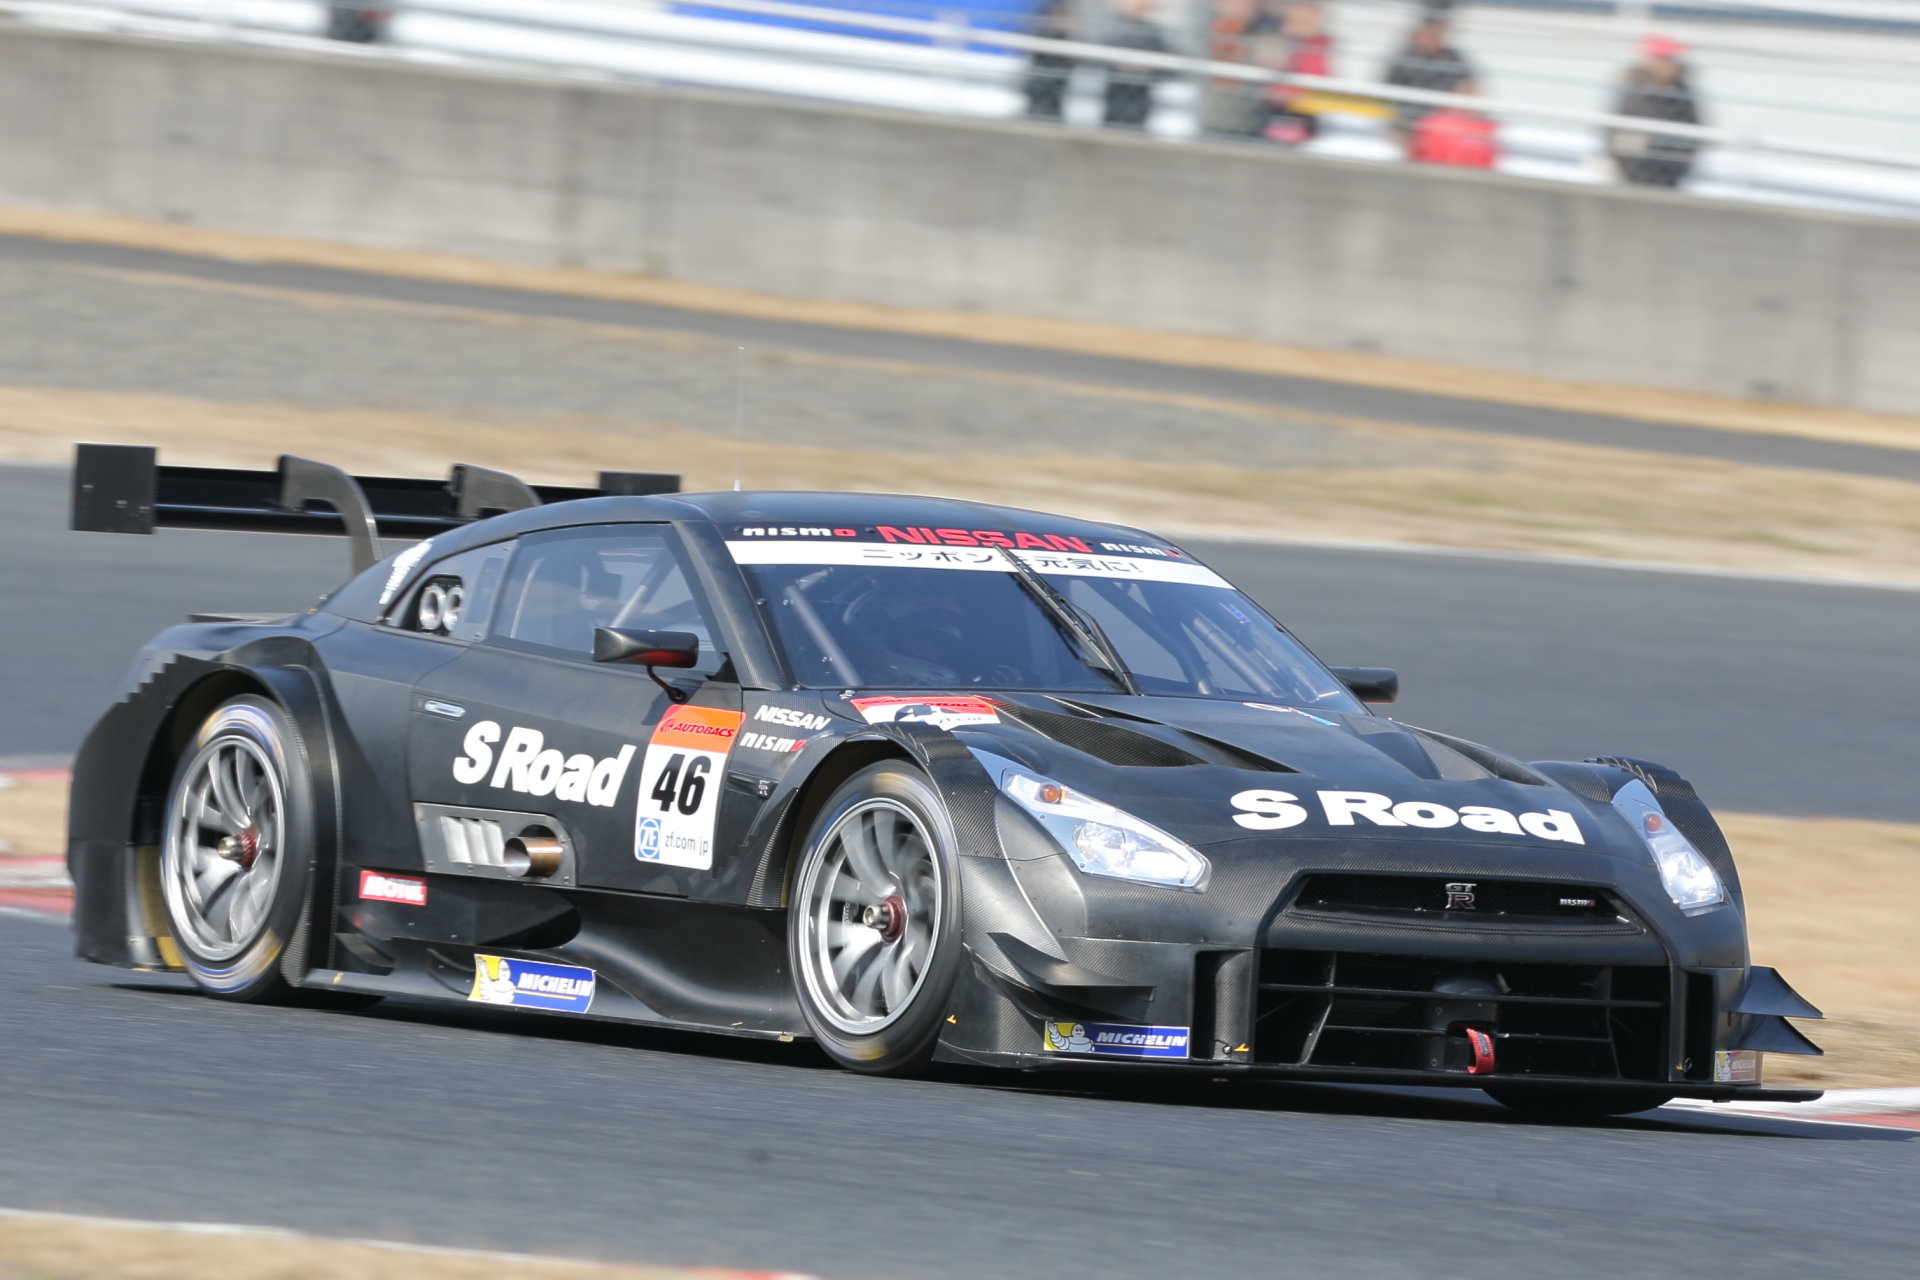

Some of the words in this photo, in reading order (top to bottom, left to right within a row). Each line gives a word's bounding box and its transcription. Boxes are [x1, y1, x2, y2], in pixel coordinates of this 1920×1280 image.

[743, 527, 857, 537] nismo
[876, 525, 1093, 553] NISSAN
[863, 549, 1143, 573] ニッポン元気に!
[673, 723, 736, 737] AUTOBACS
[754, 704, 832, 731] NISSAN
[740, 732, 808, 752] nismo
[453, 720, 502, 784] S
[490, 726, 637, 807] Road
[651, 753, 711, 816] 46
[1230, 789, 1308, 831] S
[1316, 790, 1586, 845] Road
[362, 875, 425, 901] MOTUL
[517, 972, 593, 997] MICHELIN
[1096, 1032, 1187, 1047] MICHELIN
